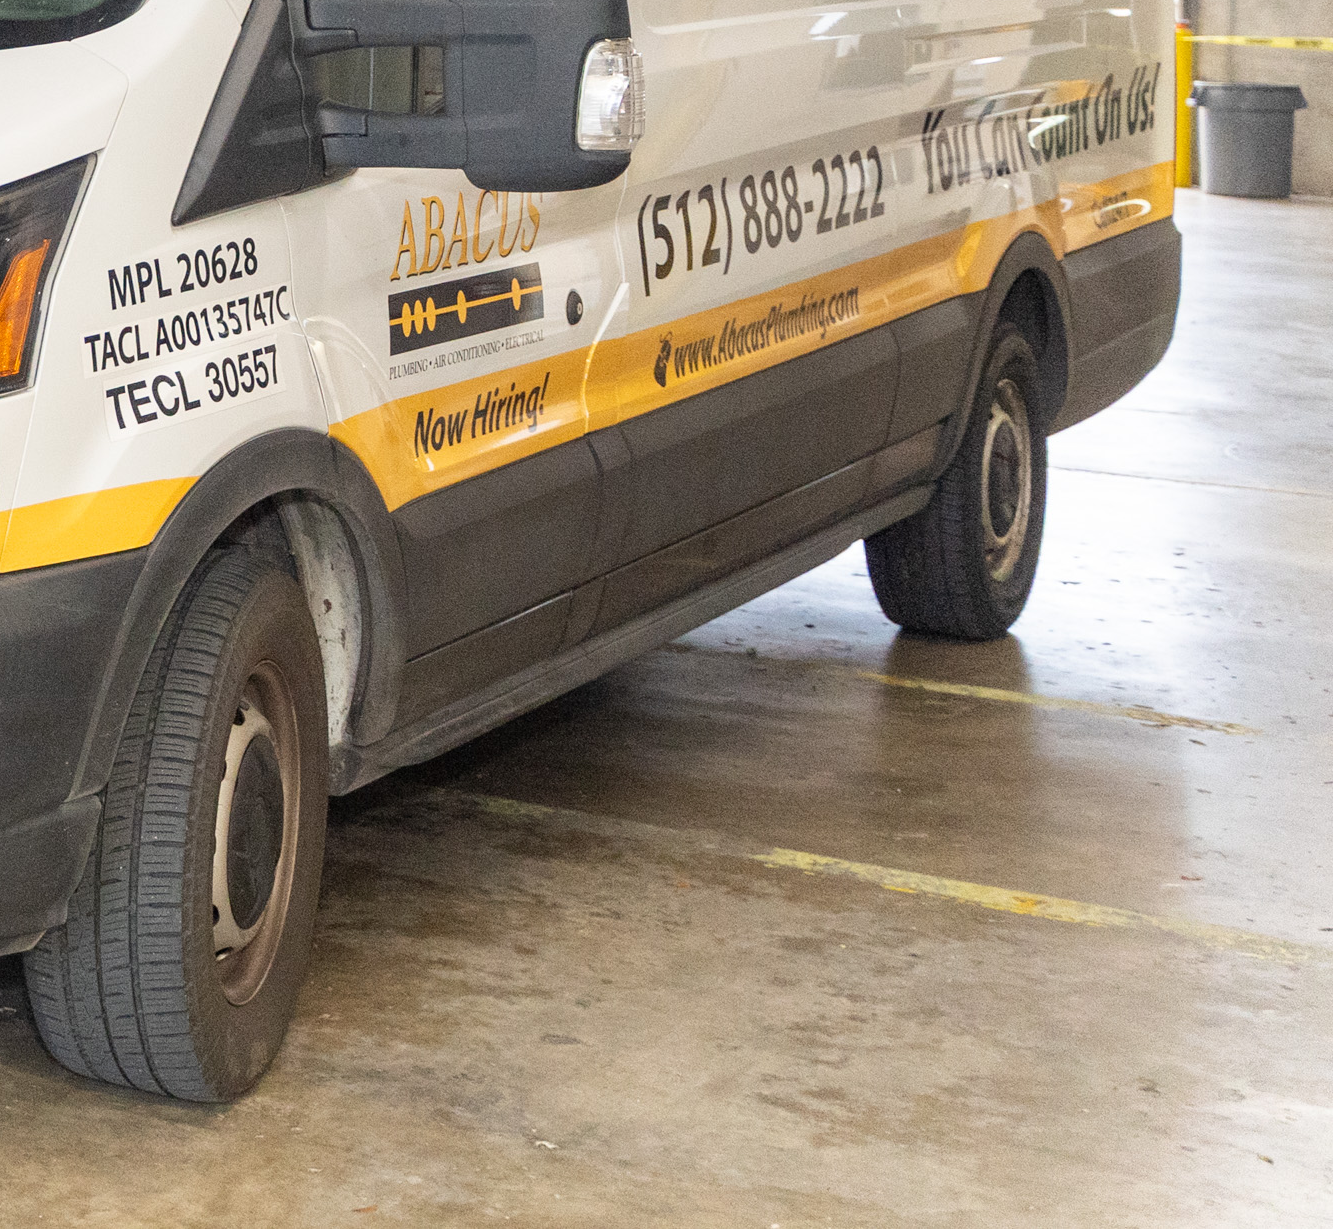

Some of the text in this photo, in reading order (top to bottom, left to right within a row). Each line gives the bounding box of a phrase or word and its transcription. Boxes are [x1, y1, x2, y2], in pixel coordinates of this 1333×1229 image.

[921, 108, 970, 194] You
[1094, 73, 1122, 146] On
[1127, 62, 1161, 136] Us!
[389, 190, 543, 281] ABACUS
[637, 145, 885, 297] (512) 888-2222
[107, 238, 258, 310] MPL 20628
[84, 285, 290, 372] TACL A00135747C
[389, 329, 544, 380] PLUMBING AIR CONDITIONING ELECTRICAL
[673, 286, 859, 378] www.AbacusPlumbing.com
[106, 344, 278, 429] TECL 30557
[414, 372, 551, 458] Now Hiring!
